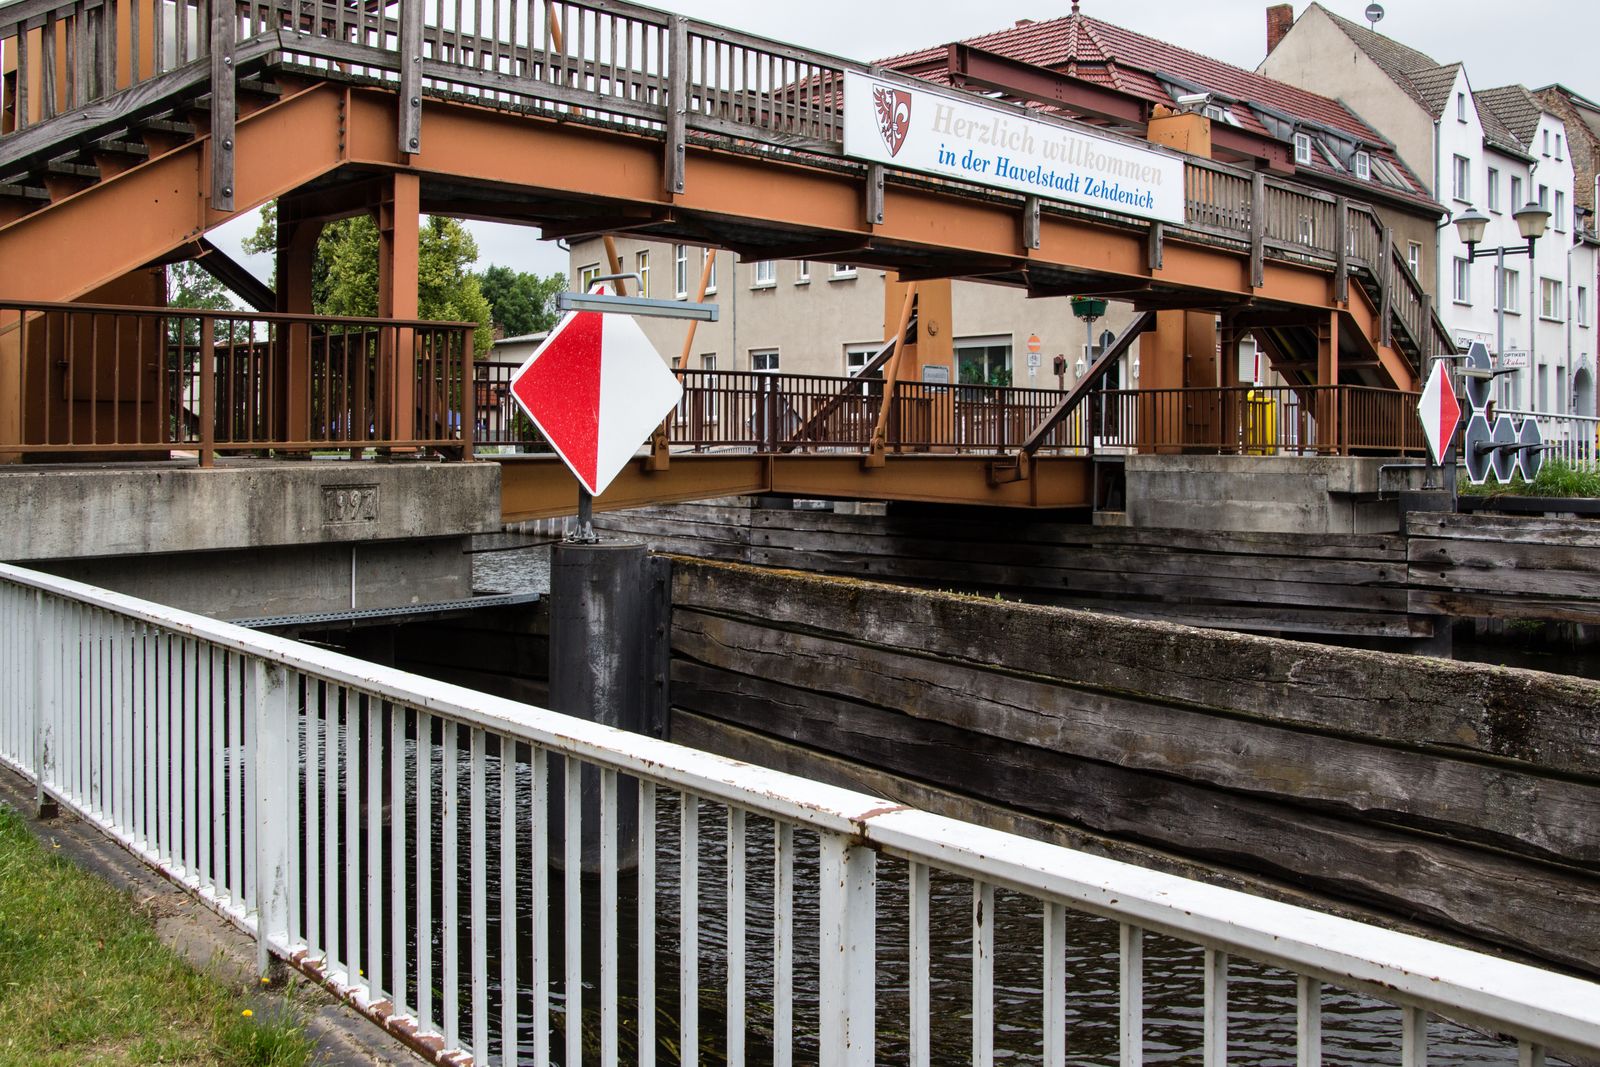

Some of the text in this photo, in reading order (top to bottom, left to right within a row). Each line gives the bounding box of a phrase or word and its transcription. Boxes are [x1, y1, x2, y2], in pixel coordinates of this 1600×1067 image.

[931, 102, 1163, 186] Herzlich willkommen
[938, 143, 1154, 209] in der Havelstadt Zehdenick
